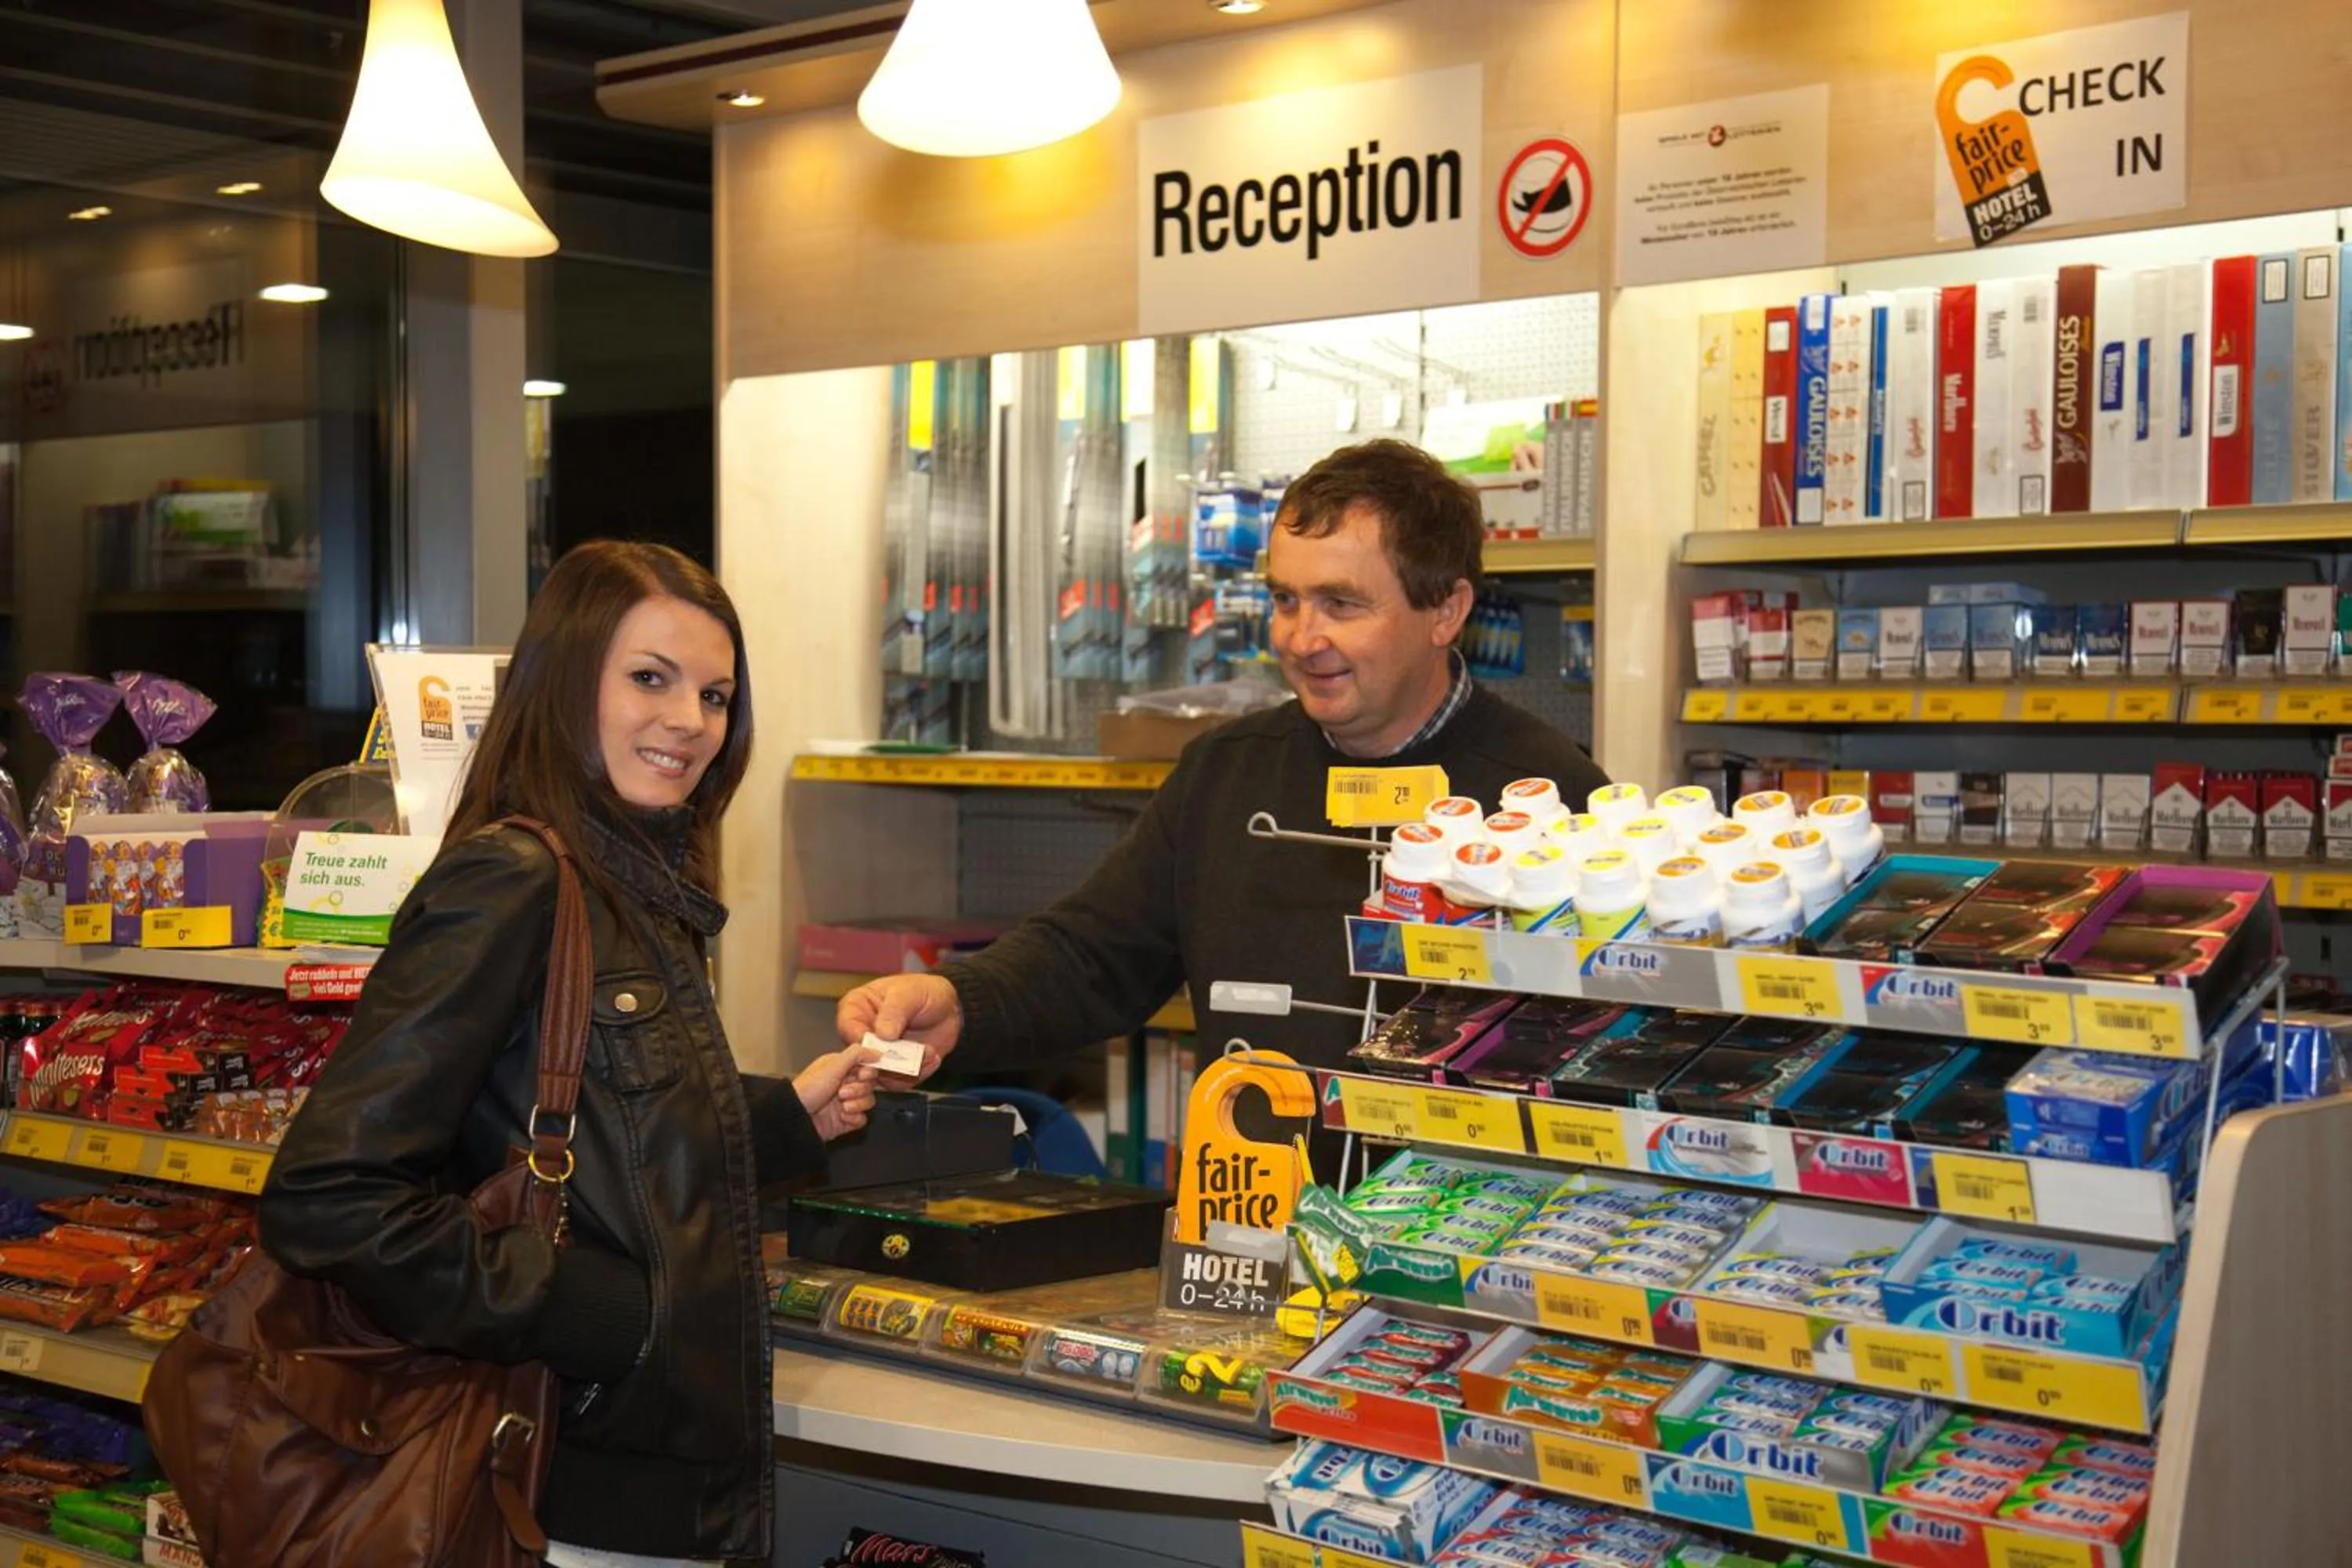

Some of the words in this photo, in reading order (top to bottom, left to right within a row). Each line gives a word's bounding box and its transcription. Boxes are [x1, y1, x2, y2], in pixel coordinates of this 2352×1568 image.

[2019, 56, 2165, 117] CHECK
[1969, 139, 2027, 194] price
[2115, 132, 2162, 177] IN
[1153, 140, 1462, 260] Reception
[1973, 183, 2038, 225] HOTEL
[2057, 314, 2081, 429] GAULOISES
[1944, 372, 1967, 433] Marlboro
[1806, 376, 1826, 478] GAULOISES
[306, 851, 345, 869] Treue
[348, 855, 388, 870] zahlt
[299, 870, 330, 885] sich
[334, 874, 365, 887] aus.
[1598, 948, 1658, 972] Orbit
[1886, 971, 1957, 999] Orbit
[1666, 1123, 1729, 1151] Orbit
[1818, 1139, 1887, 1171] Orbit
[1196, 1142, 1270, 1194] fair-
[1386, 1175, 1446, 1190] Orbit
[1367, 1192, 1428, 1207] Orbit
[1462, 1196, 1517, 1216] Orbit
[1199, 1192, 1279, 1241] price
[1443, 1213, 1501, 1234] Orbit
[1557, 1208, 1616, 1229] Orbit
[1421, 1231, 1480, 1251] Orbit
[1539, 1226, 1599, 1247] Orbit
[1646, 1225, 1707, 1245] Orbit
[1627, 1243, 1689, 1263] Orbit
[1984, 1243, 2056, 1263] Orbit
[1182, 1252, 1269, 1287] HOTEL
[1611, 1261, 1675, 1280] Orbit
[1954, 1260, 2029, 1281] Orbit
[1736, 1279, 1802, 1296] Orbit
[1938, 1296, 2066, 1344] Orbit
[1735, 1392, 1802, 1411] Orbit
[1463, 1419, 1521, 1448] Orbit
[1716, 1413, 1784, 1433] Orbit
[1816, 1430, 1868, 1450] Orb
[1969, 1425, 2042, 1449] Orbit
[1710, 1428, 1822, 1478] Orbit
[1955, 1446, 2029, 1469] Orbit
[1671, 1465, 1735, 1496] Orbit
[1914, 1479, 1987, 1502] Orbit
[1935, 1467, 2008, 1491] Orbit
[2050, 1478, 2129, 1503] Orbit
[2032, 1501, 2113, 1526] Orbit
[1603, 1522, 1667, 1543] Orbit
[1891, 1511, 1963, 1541] Orbit
[851, 1533, 935, 1564] Mars
[1318, 1527, 1384, 1557] Orbit
[1476, 1540, 1534, 1563] Orbit
[1587, 1539, 1646, 1563] Orbit
